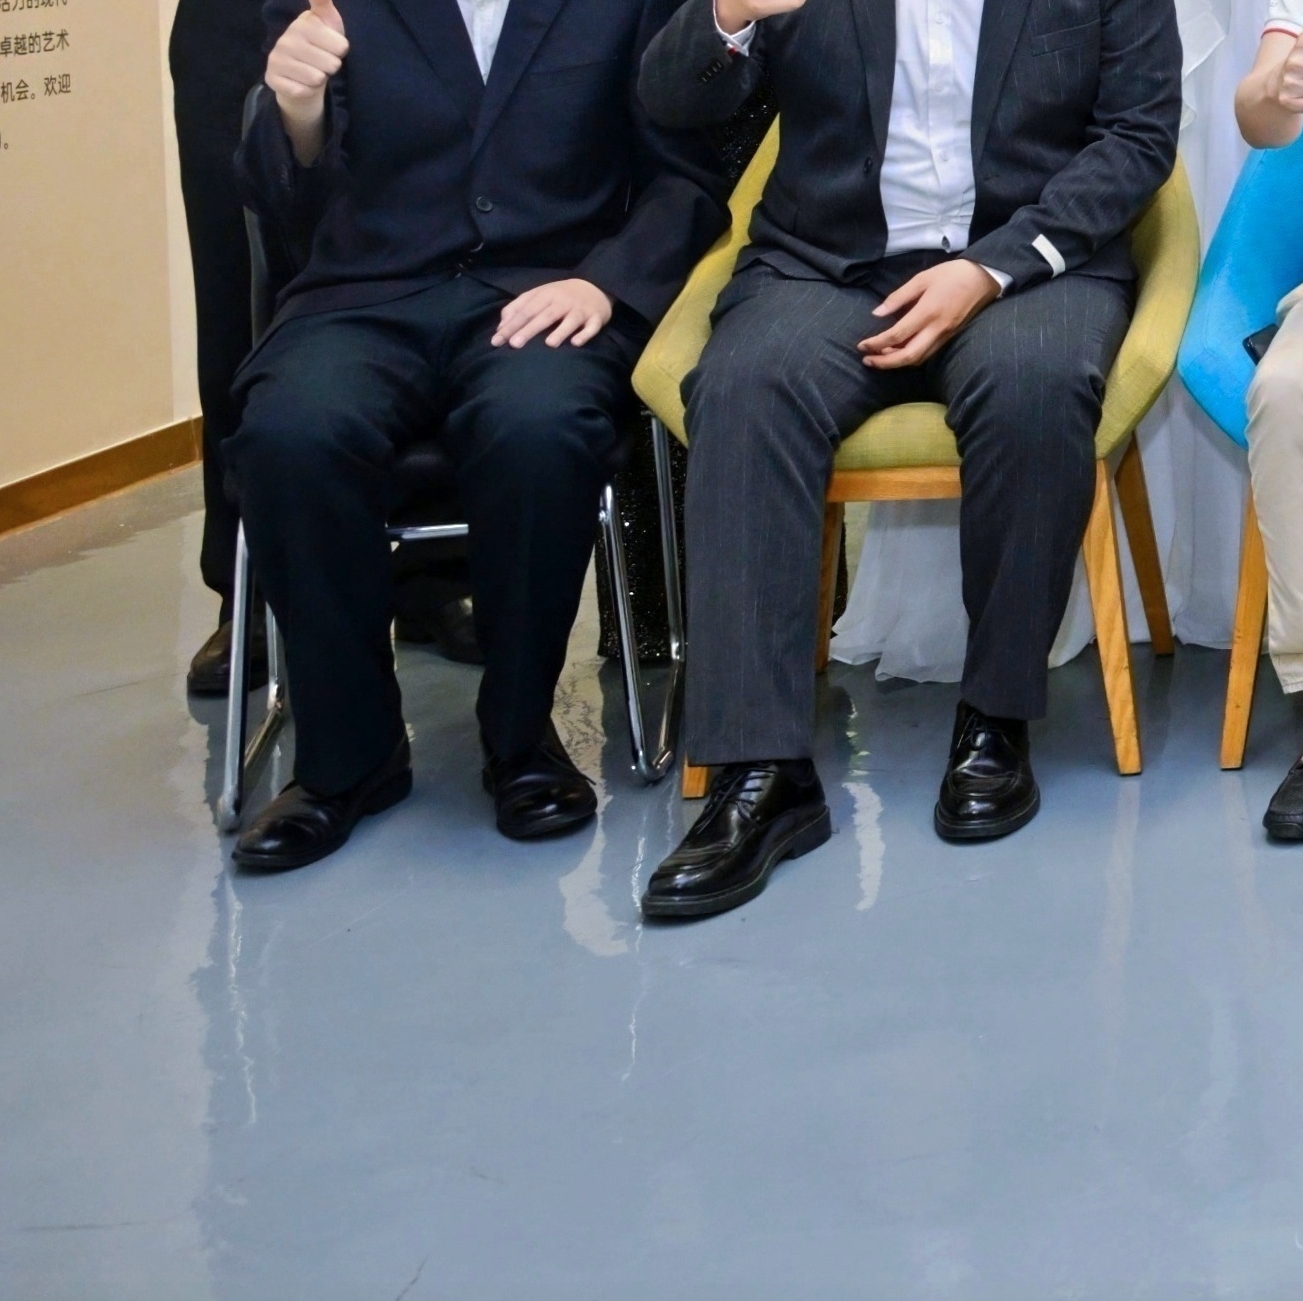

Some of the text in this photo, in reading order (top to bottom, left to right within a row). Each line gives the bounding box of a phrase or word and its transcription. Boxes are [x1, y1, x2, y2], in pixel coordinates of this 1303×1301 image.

[0, 29, 70, 58] 卓越的艺术
